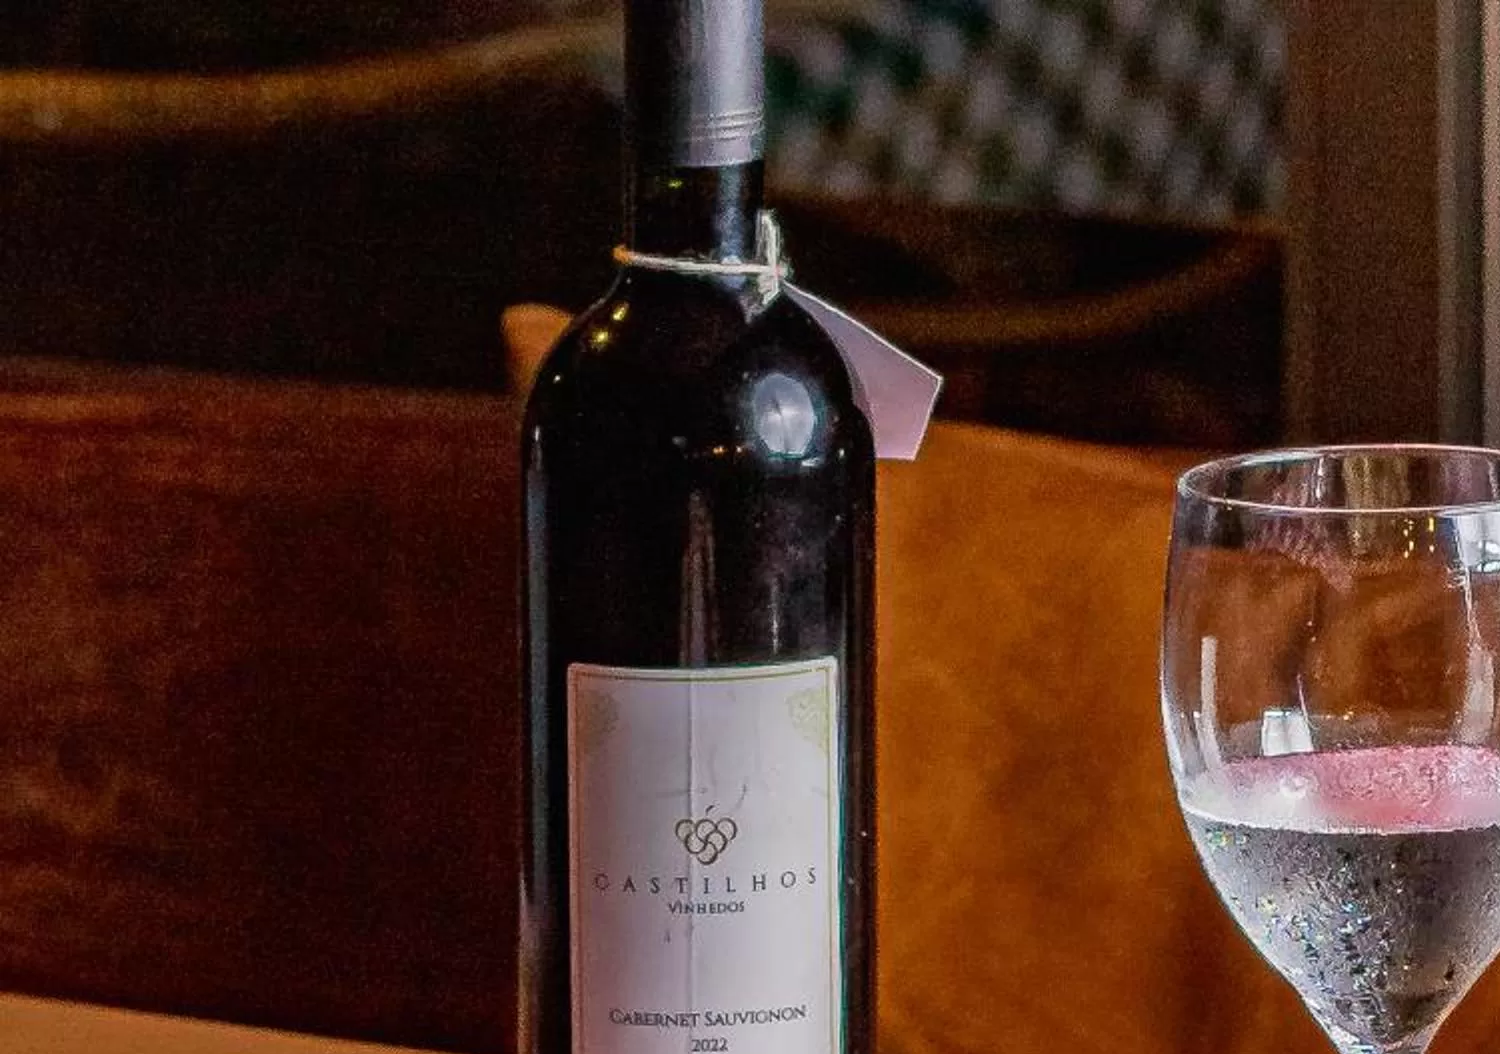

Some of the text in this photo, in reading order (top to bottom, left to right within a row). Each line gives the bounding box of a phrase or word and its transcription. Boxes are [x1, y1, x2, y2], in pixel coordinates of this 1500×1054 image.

[592, 866, 817, 894] CASTILHOS
[668, 901, 746, 916] VINHEDOS
[609, 1004, 808, 1028] CABERNET SAUVIGNON
[691, 1037, 729, 1052] 2022
